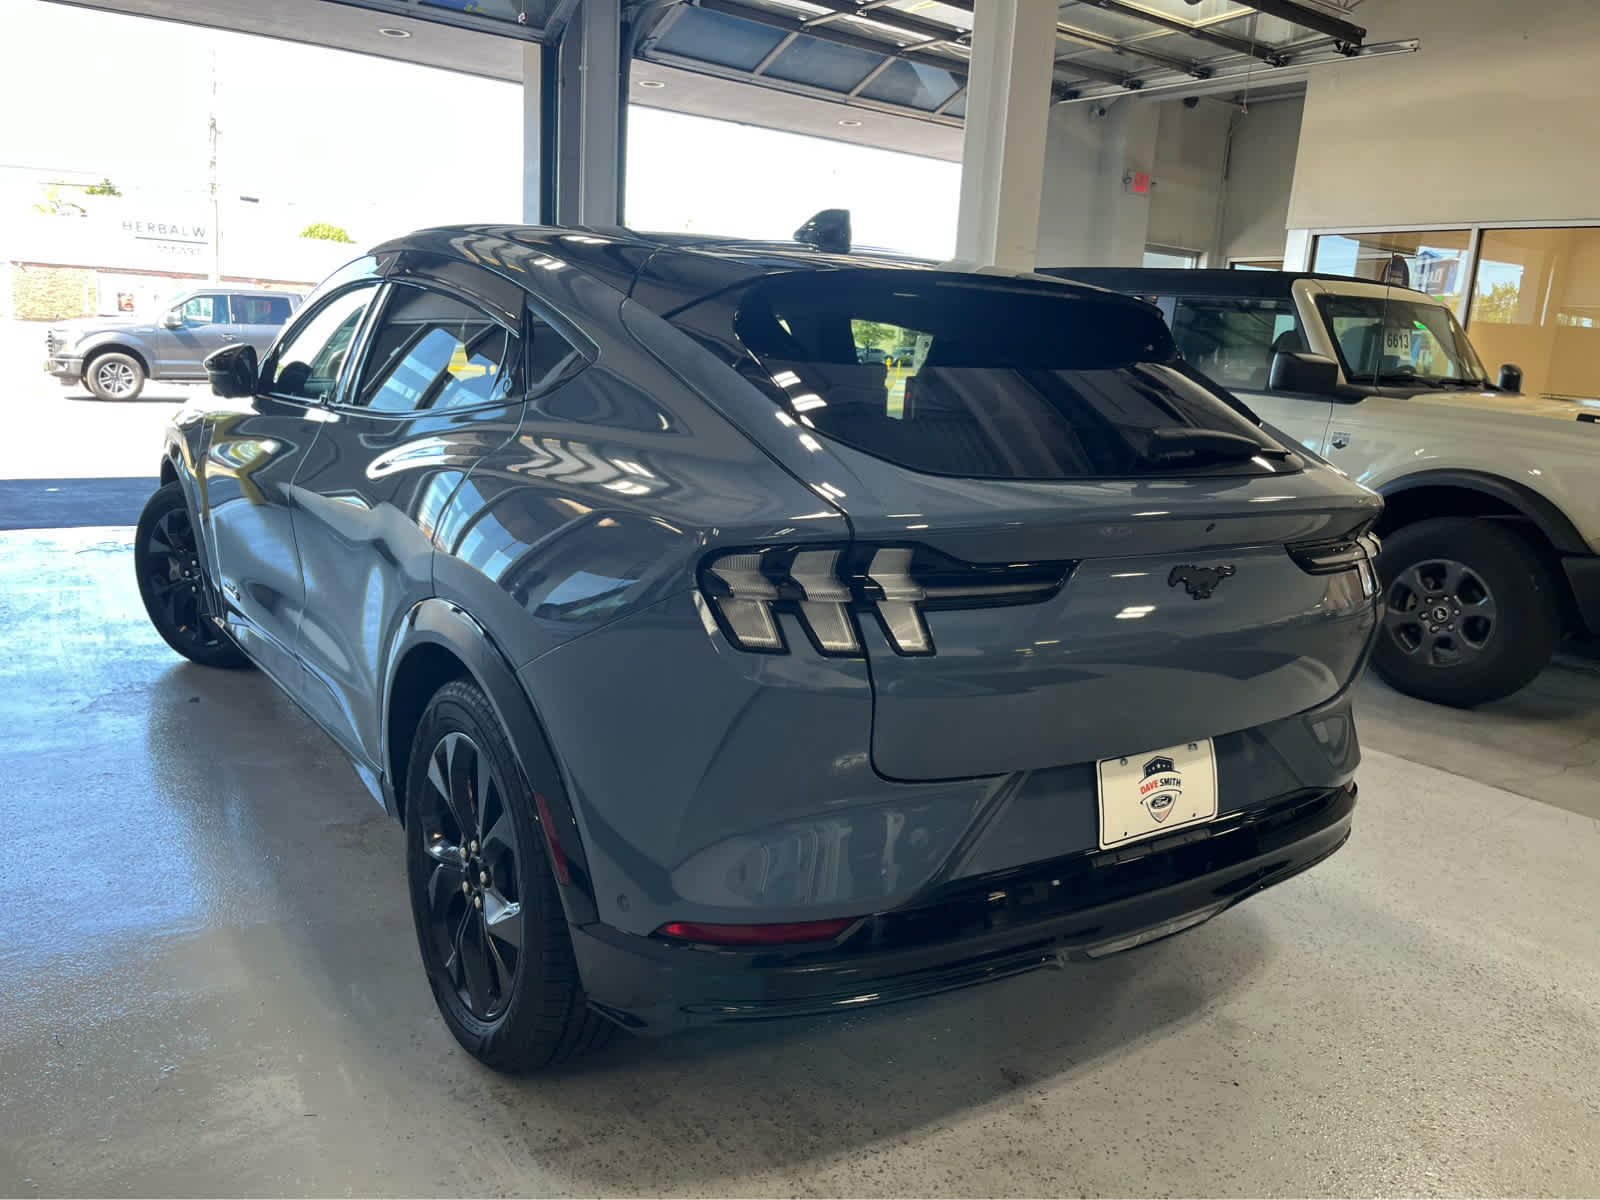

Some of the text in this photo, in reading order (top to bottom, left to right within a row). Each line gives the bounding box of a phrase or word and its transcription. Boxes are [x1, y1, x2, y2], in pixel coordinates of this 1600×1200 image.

[1386, 334, 1409, 349] 6613
[1140, 777, 1181, 795] DAVE SMITH
